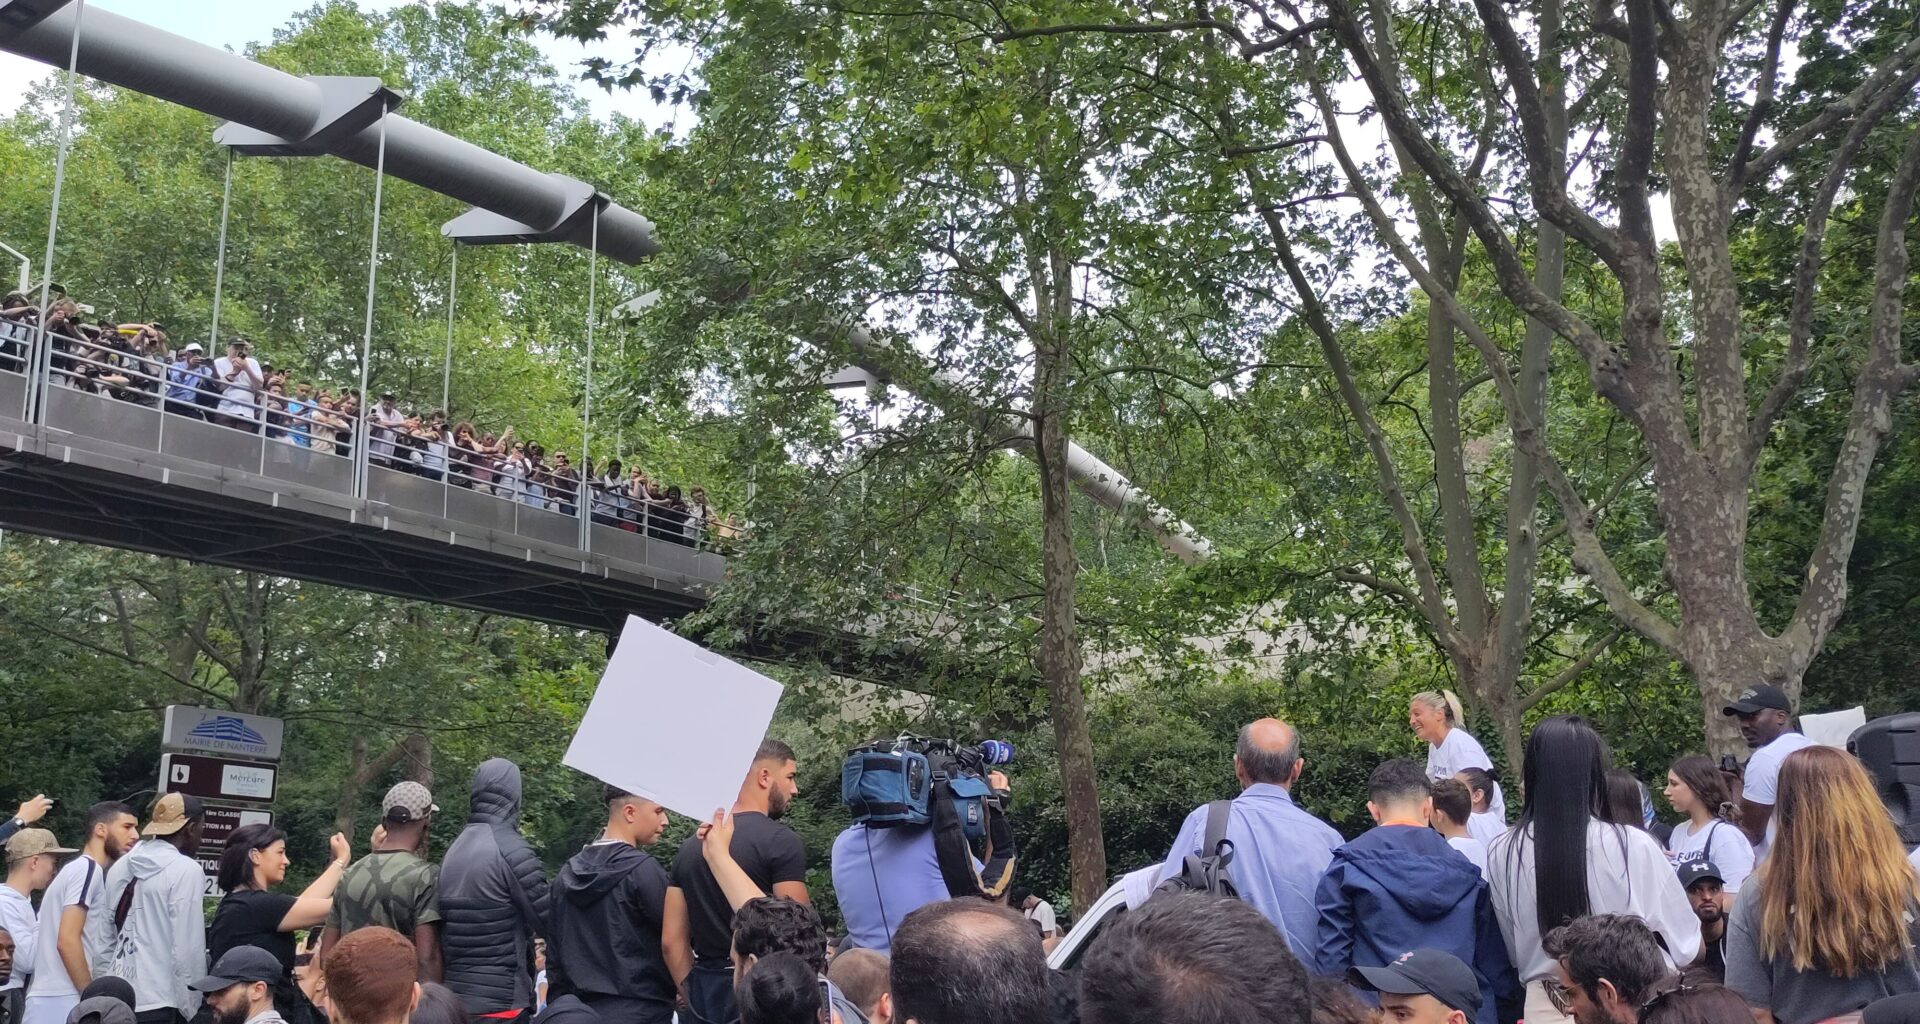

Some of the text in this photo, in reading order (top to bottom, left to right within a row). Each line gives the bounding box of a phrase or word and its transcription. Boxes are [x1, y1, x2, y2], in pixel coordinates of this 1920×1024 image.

[184, 738, 269, 753] MAIRIE DE NANTERRE
[230, 774, 266, 783] Mercure
